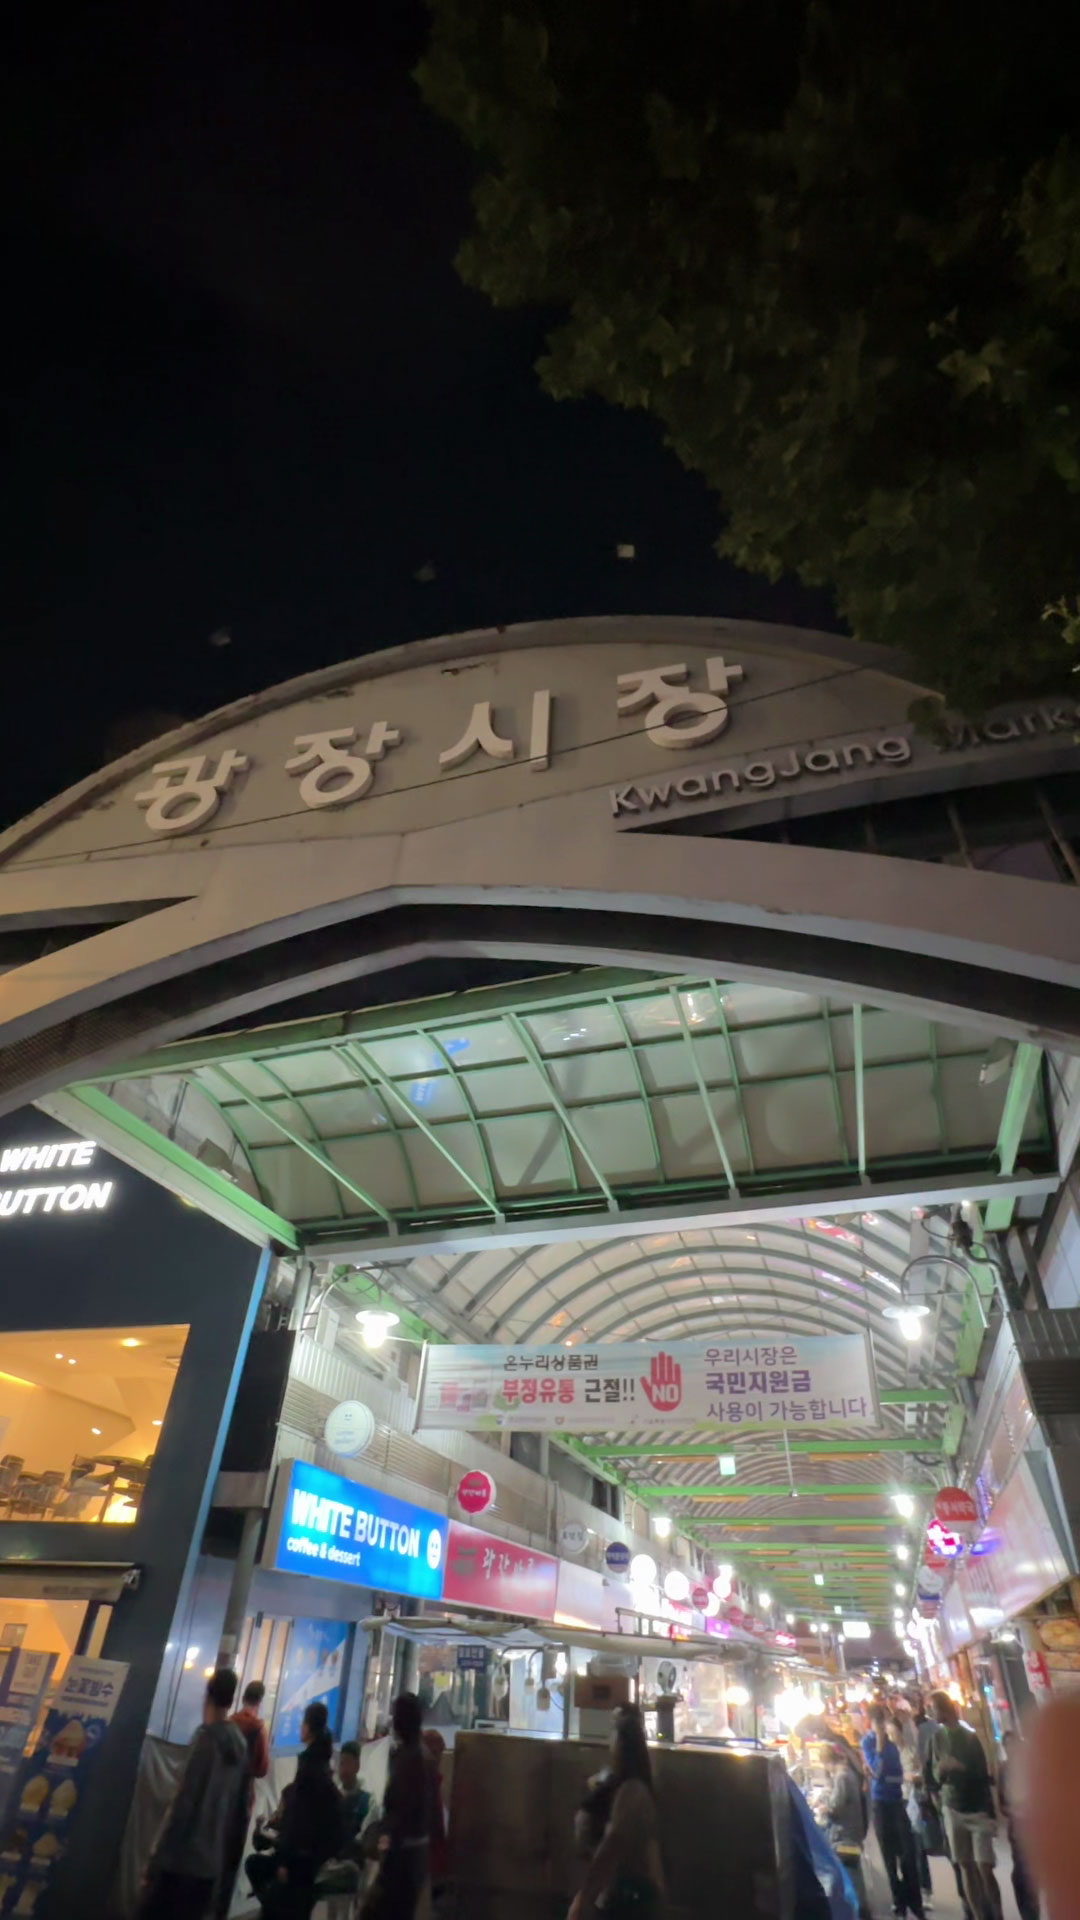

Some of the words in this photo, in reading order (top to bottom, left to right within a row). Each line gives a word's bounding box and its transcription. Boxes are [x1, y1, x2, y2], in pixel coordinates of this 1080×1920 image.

[135, 655, 746, 836] 광장시장
[609, 736, 913, 817] KwangJang
[0, 1140, 97, 1173] WHITE
[0, 1181, 113, 1217] UTTON
[503, 1354, 599, 1371] 온누리상품권
[704, 1346, 798, 1366] 우리시장은
[502, 1378, 575, 1403] 부정유통
[584, 1377, 635, 1403] 근절!!
[651, 1383, 680, 1403] NO
[705, 1369, 812, 1394] 국민지원금
[707, 1400, 764, 1424] 사용이
[291, 1488, 355, 1539] WHITE
[354, 1510, 421, 1558] BUTTON
[286, 1536, 318, 1558] coffee
[328, 1544, 362, 1567] dessert
